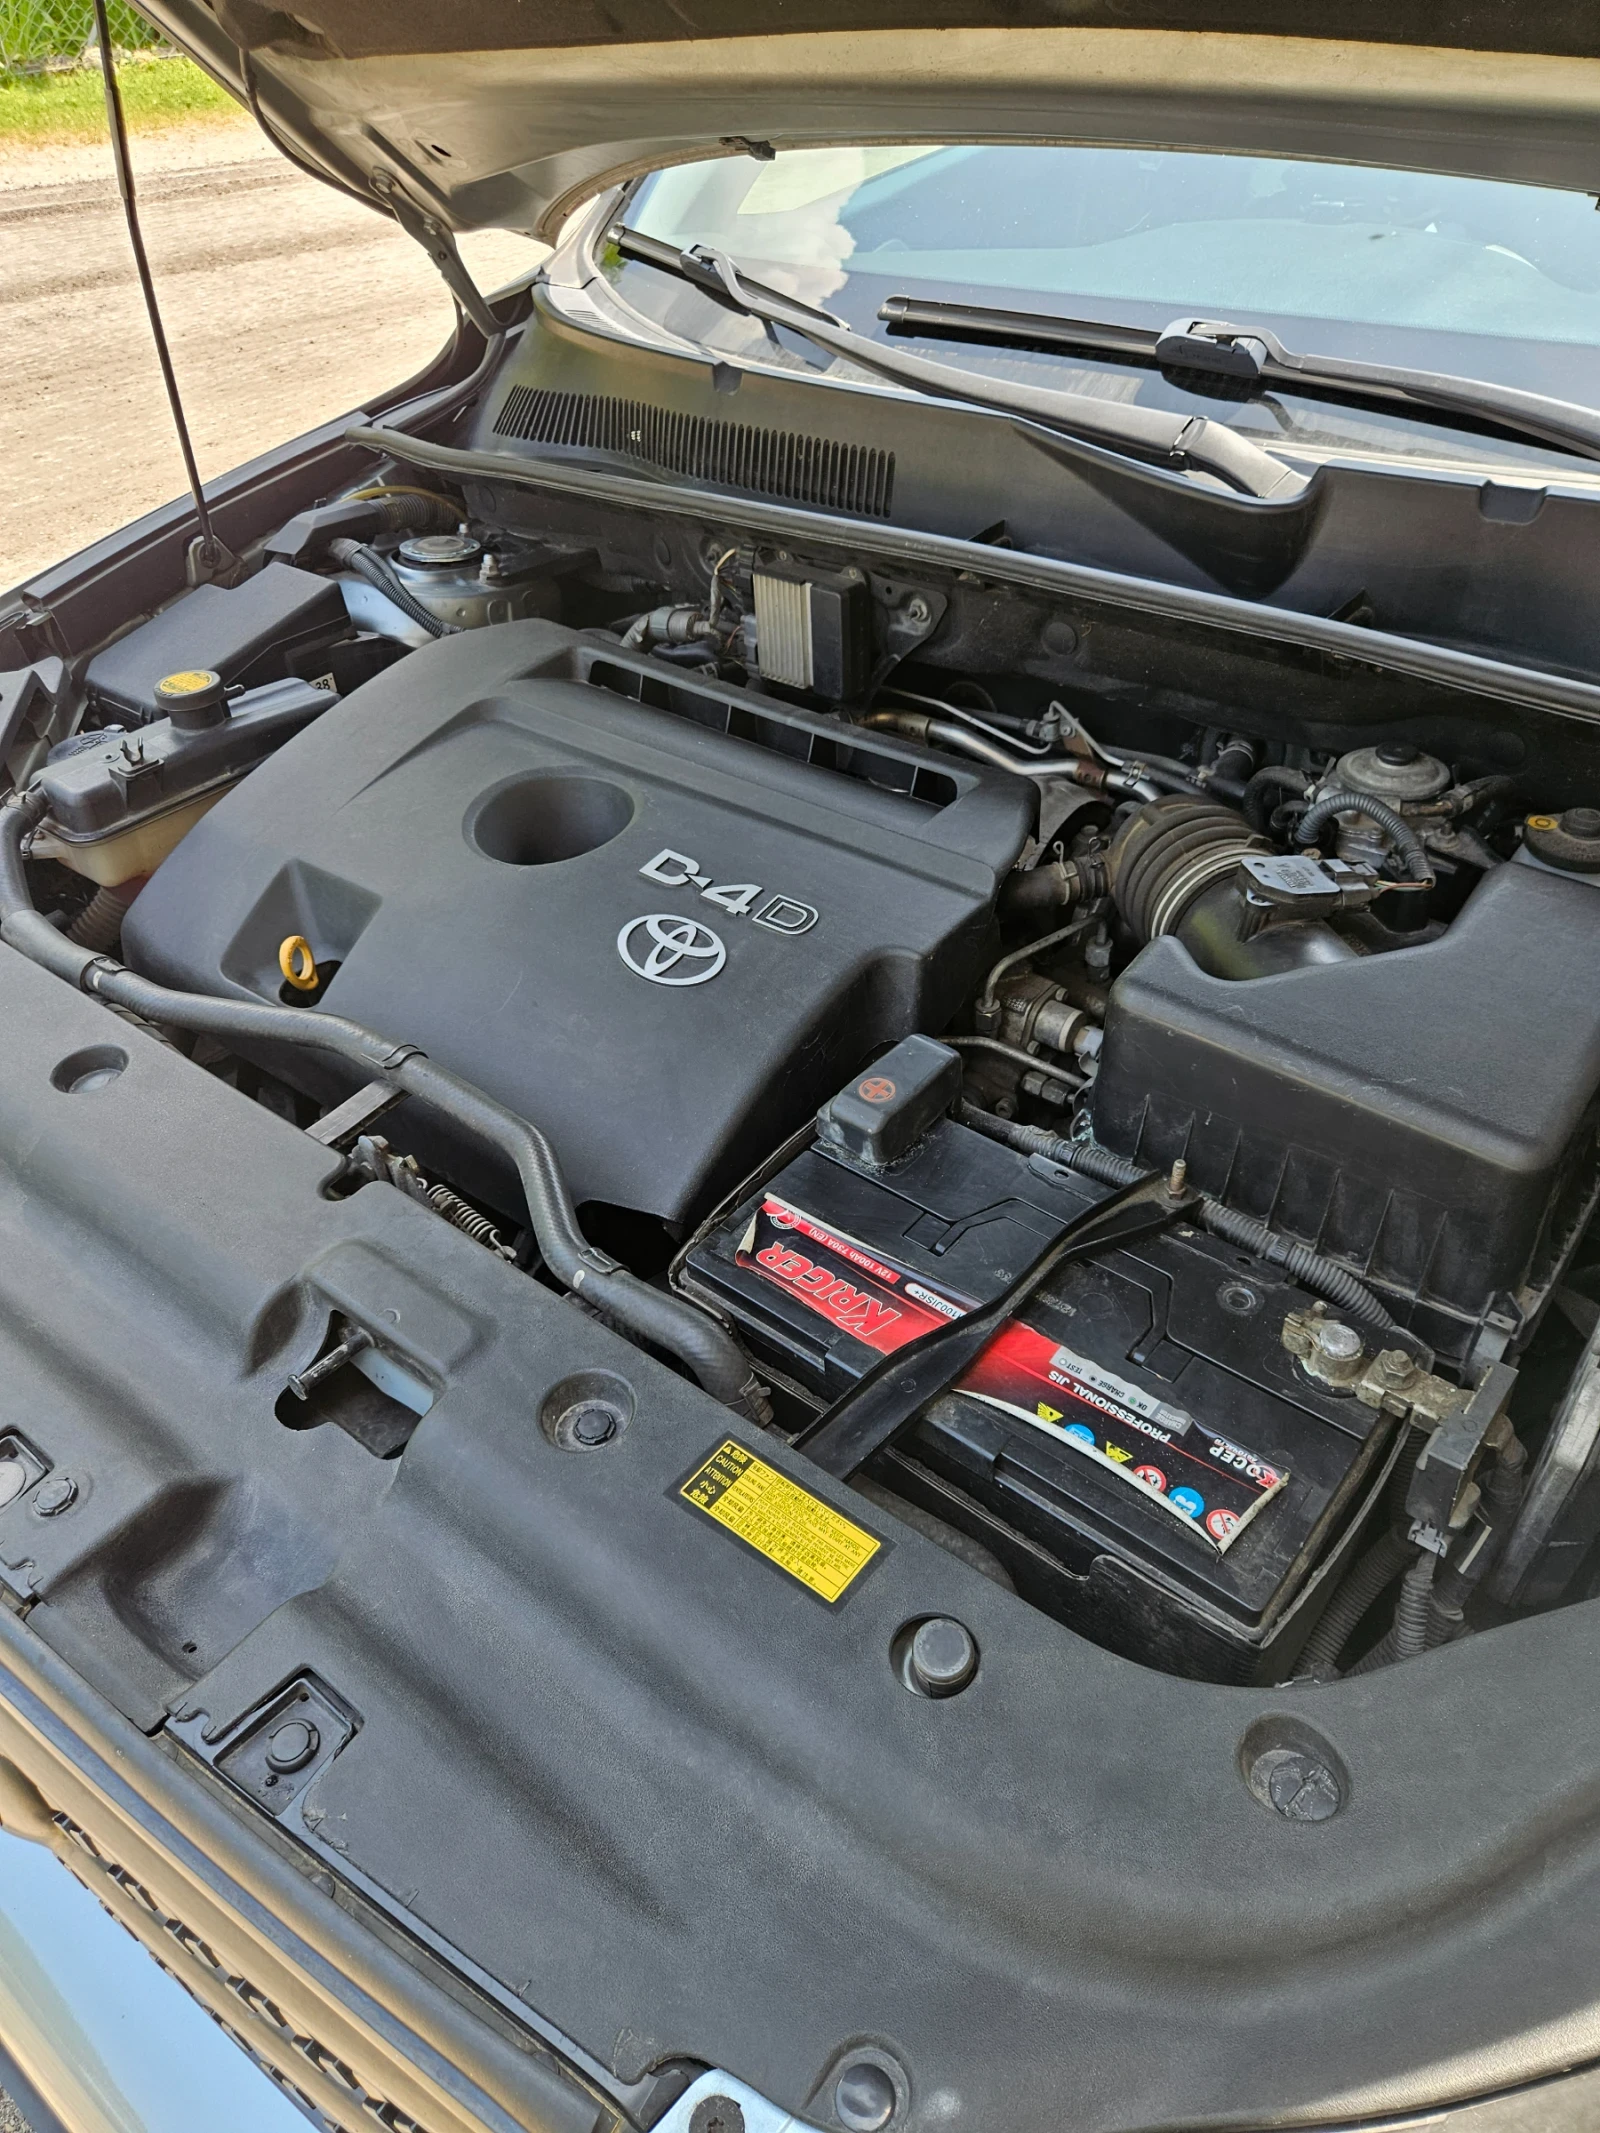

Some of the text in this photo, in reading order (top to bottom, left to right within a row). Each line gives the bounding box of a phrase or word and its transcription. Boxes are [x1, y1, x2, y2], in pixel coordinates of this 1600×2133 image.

[808, 1227, 893, 1281] 12V 100Ah 730A (EN)
[755, 1241, 902, 1337] KRIGER
[1048, 1370, 1172, 1443] PROFESSIONAL JIS
[1065, 1362, 1148, 1412] OK CHARGE TEST
[698, 1479, 718, 1495] 小心
[704, 1466, 731, 1487] ATTENTION
[715, 1454, 743, 1476] CAUTION
